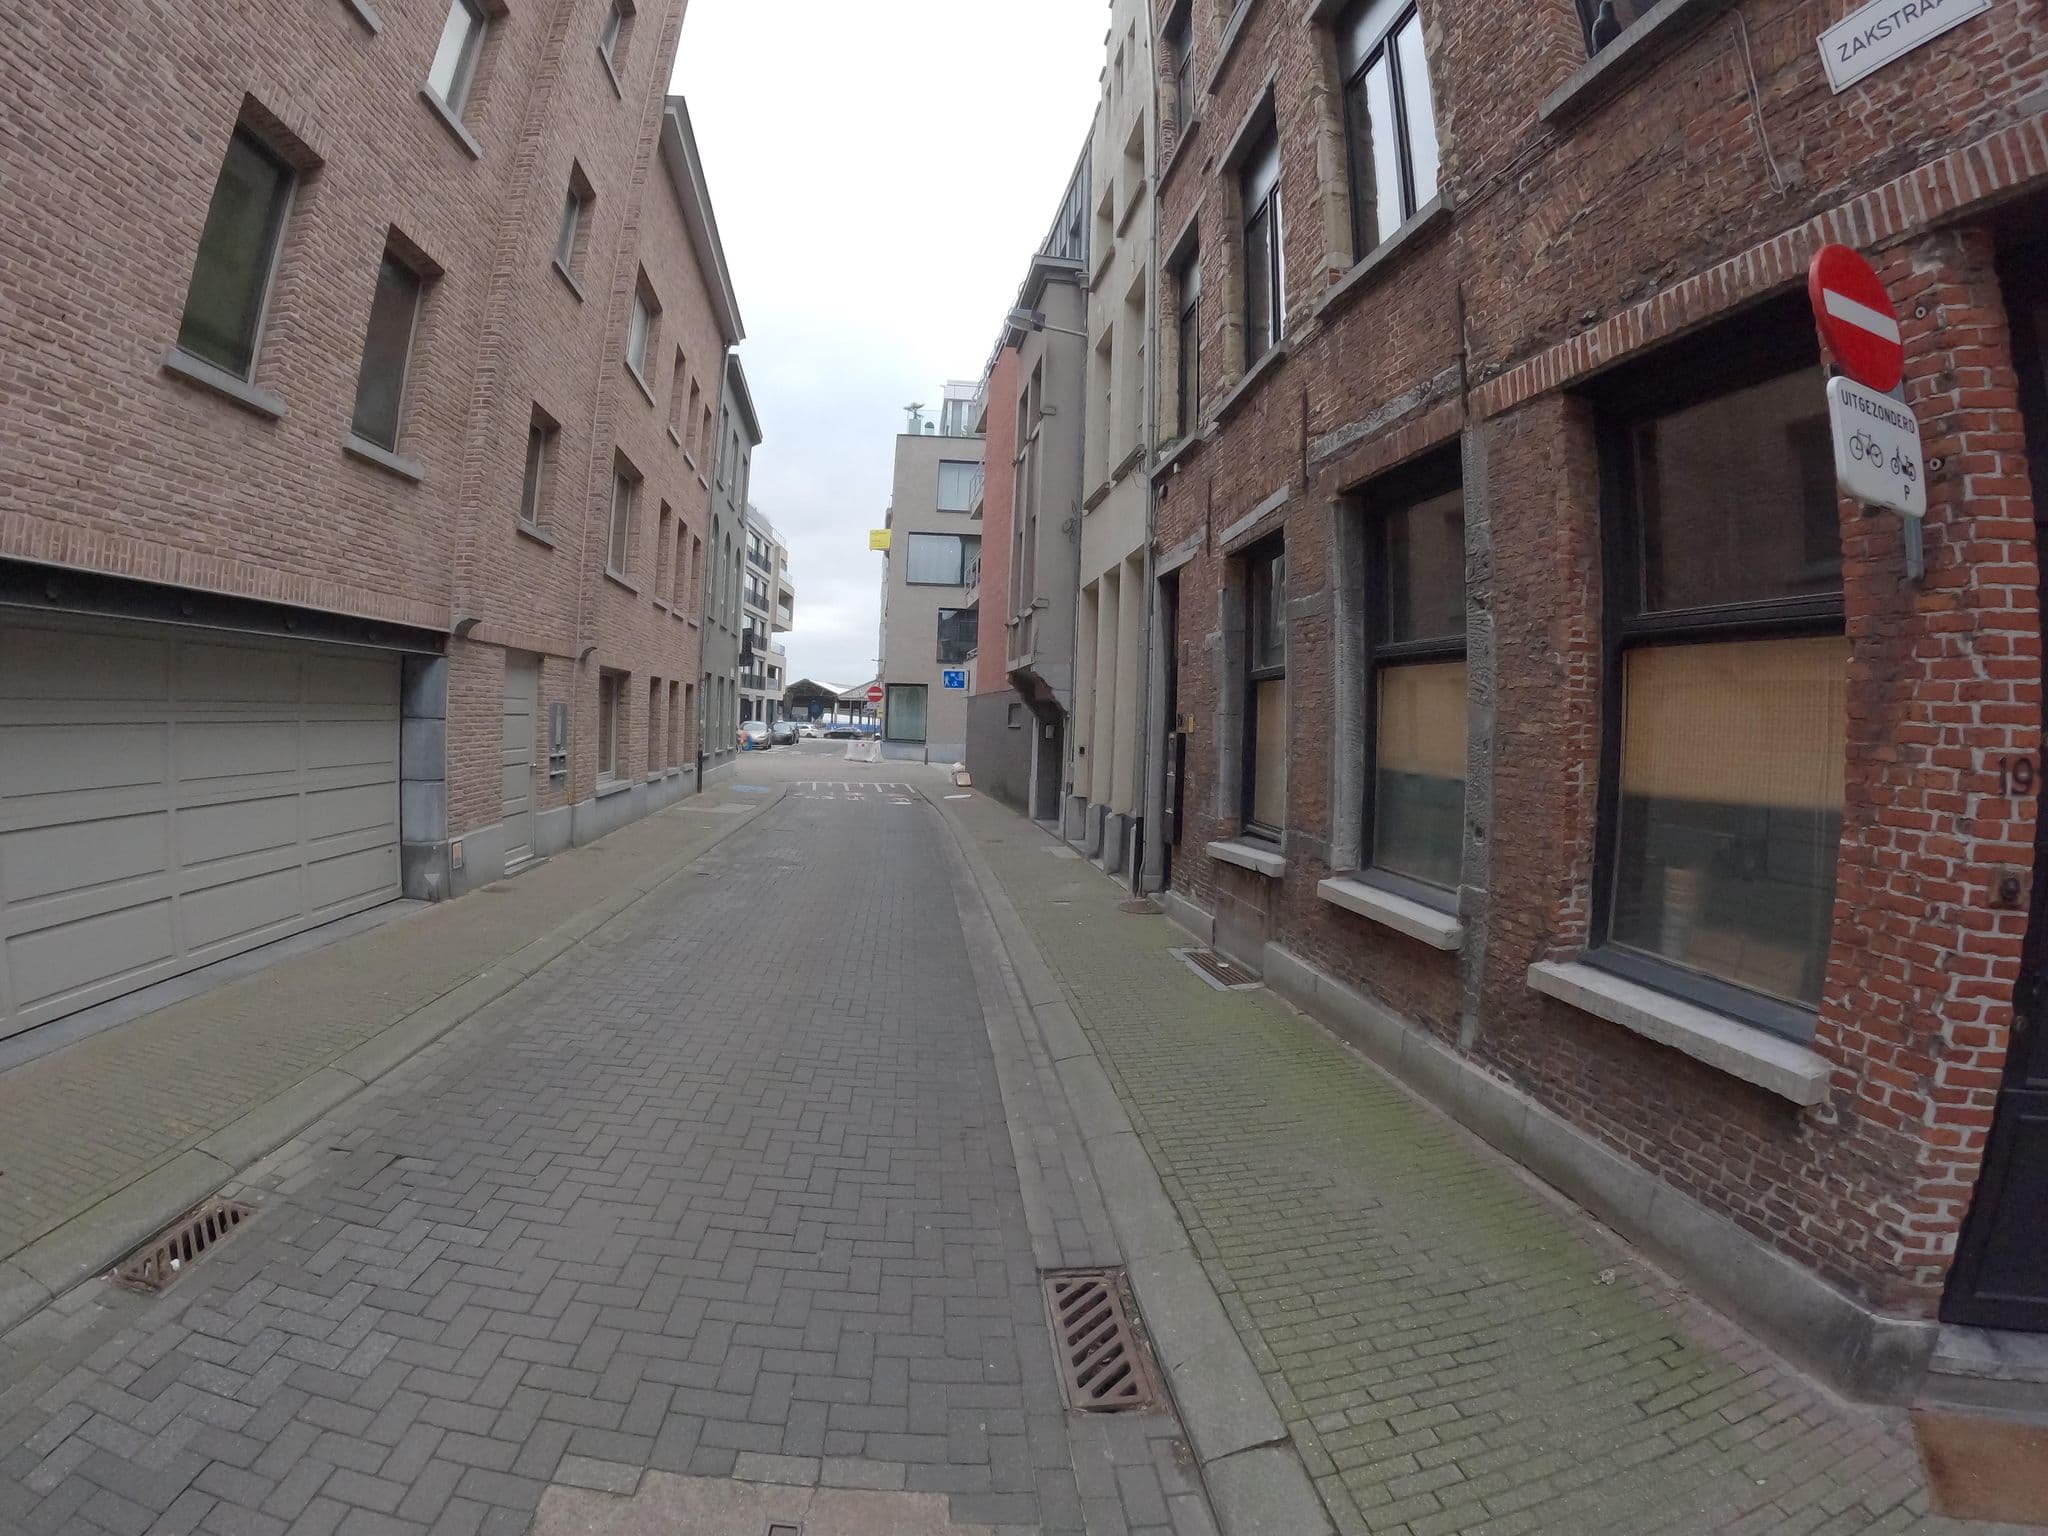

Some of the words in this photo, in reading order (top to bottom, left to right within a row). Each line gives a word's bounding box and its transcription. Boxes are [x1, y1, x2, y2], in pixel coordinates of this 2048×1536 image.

[1837, 0, 1943, 62] ZAKSTRA
[1841, 389, 1915, 434] UITGEZONDERD
[1904, 484, 1911, 500] P
[1999, 755, 2034, 796] 19
